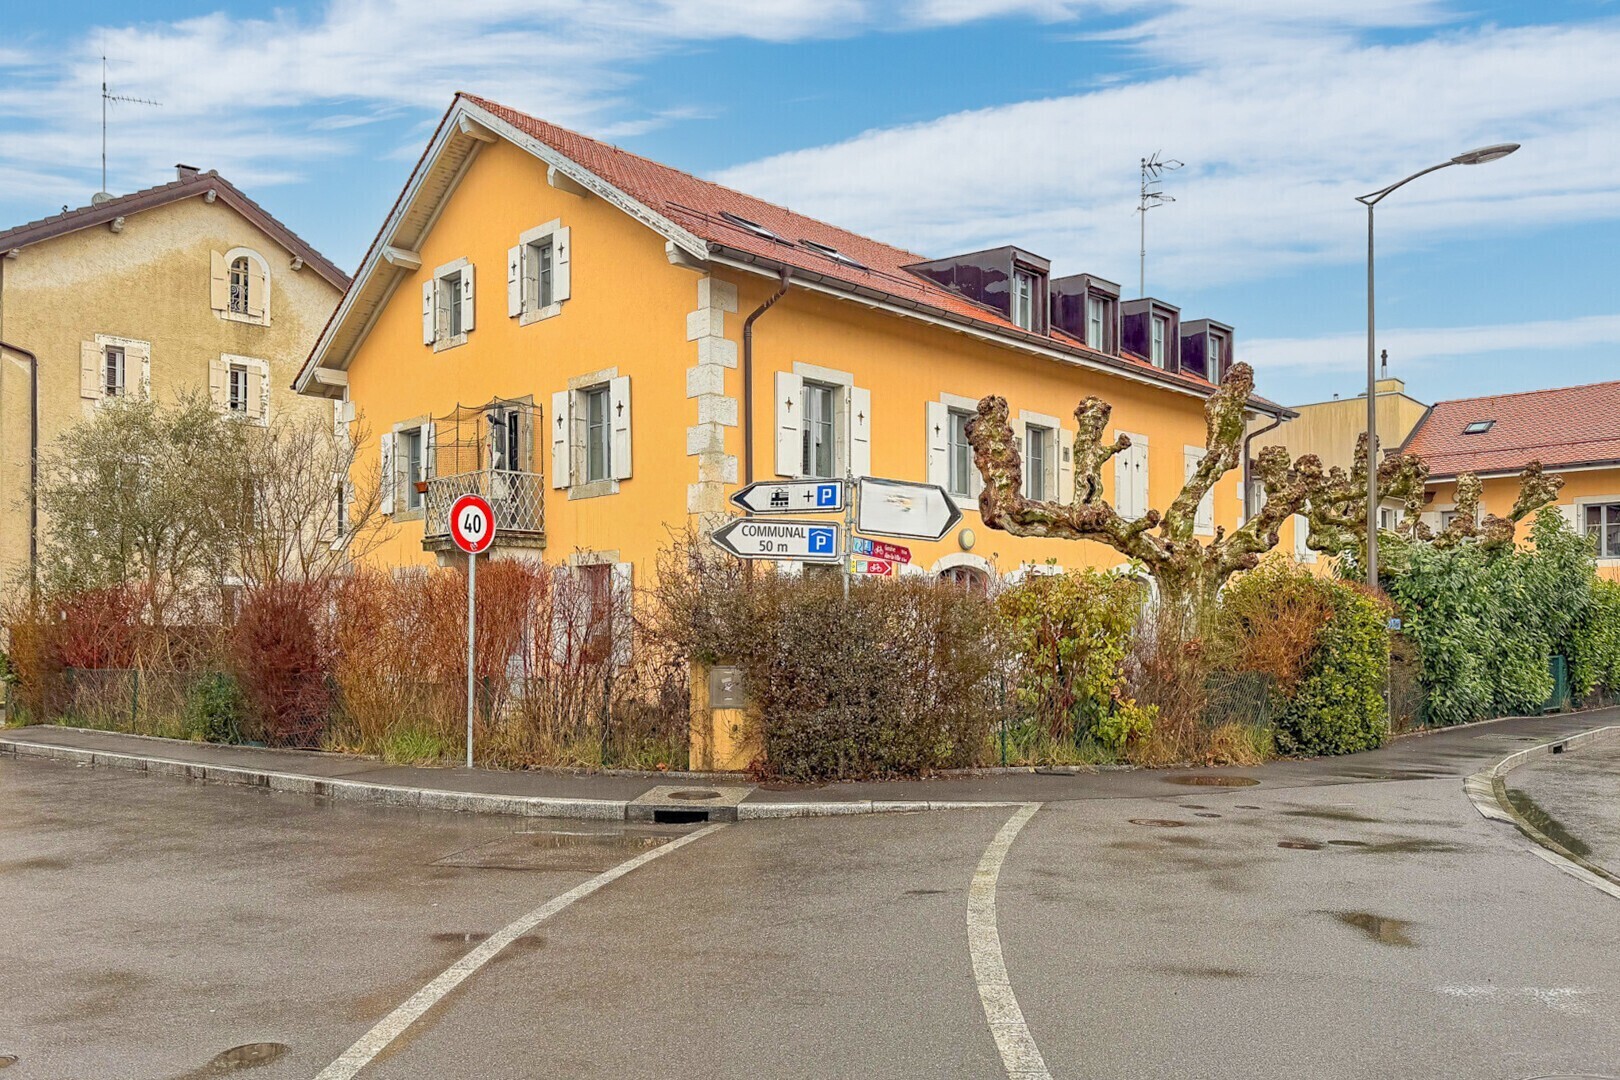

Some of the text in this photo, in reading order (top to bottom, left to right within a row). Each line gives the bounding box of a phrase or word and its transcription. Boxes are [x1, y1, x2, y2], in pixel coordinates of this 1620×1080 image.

[822, 488, 832, 504] P
[464, 513, 481, 533] 40
[741, 525, 806, 539] COMMUNAL
[759, 540, 788, 552] 50 m
[816, 536, 826, 550] P
